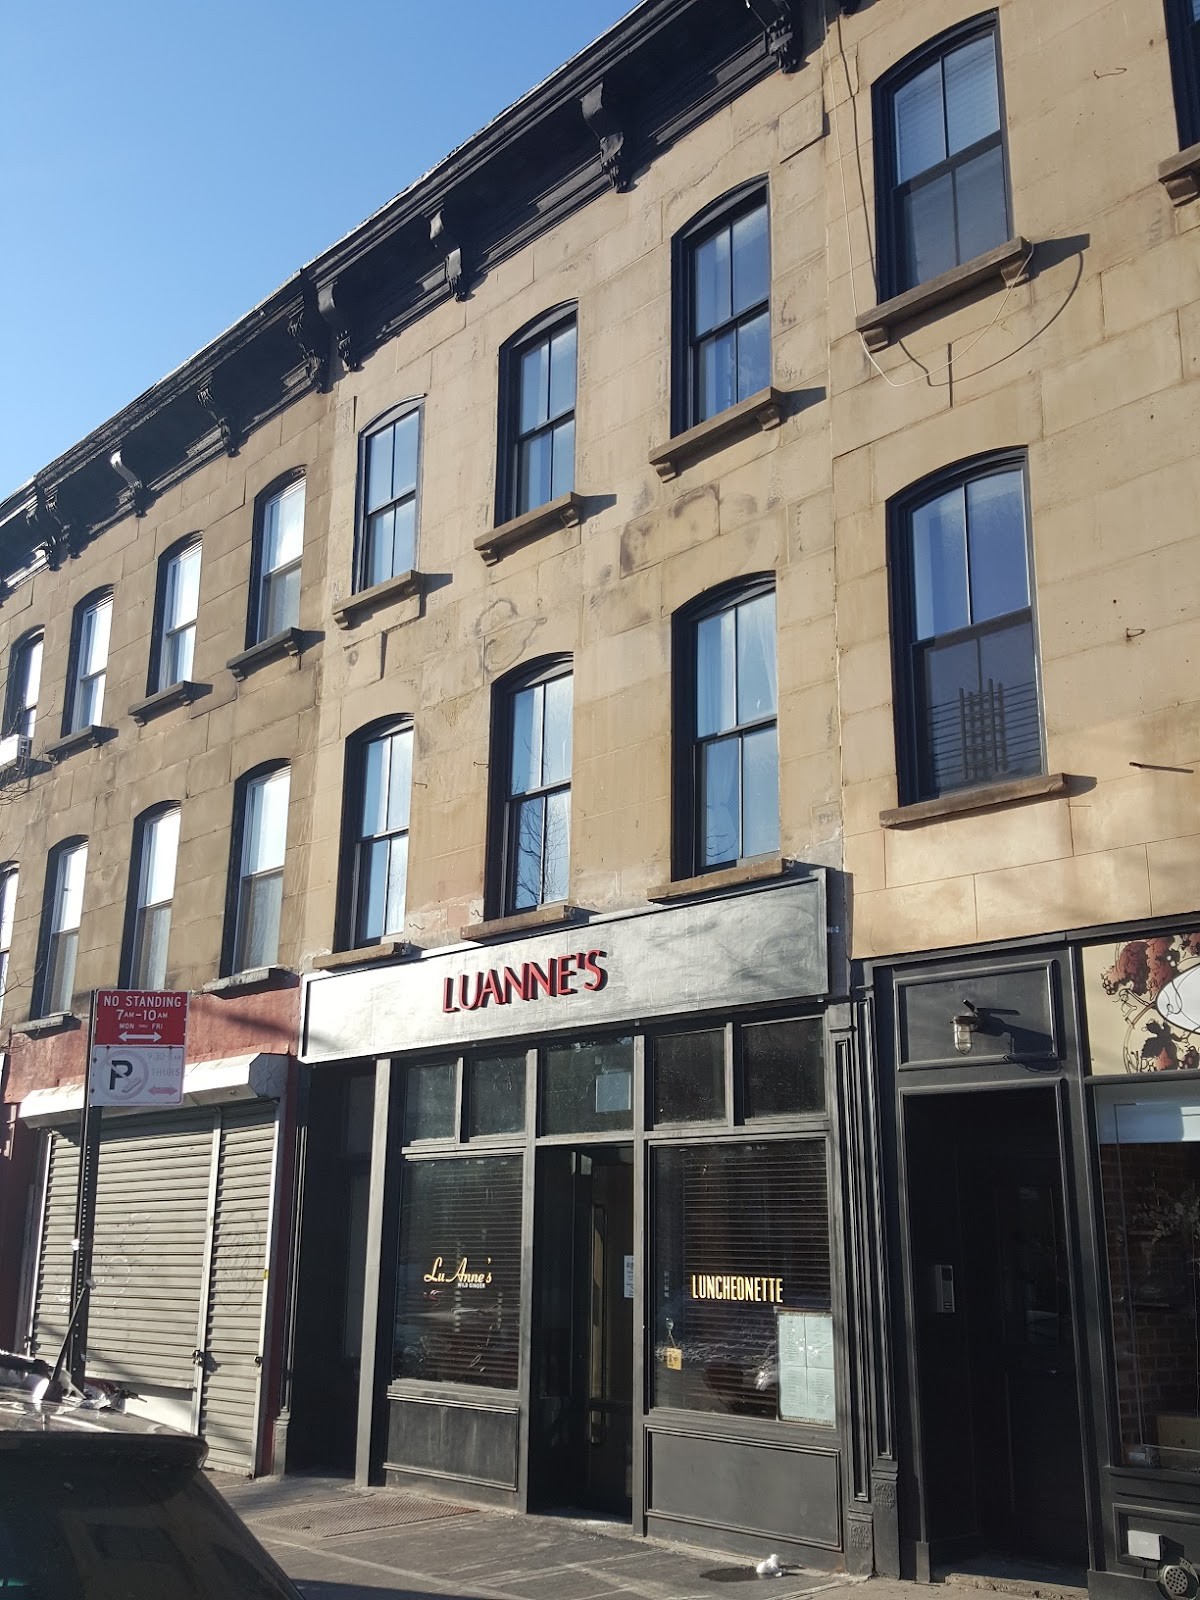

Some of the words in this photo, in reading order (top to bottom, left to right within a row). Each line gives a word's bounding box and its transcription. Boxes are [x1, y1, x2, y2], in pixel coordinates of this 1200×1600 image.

[443, 950, 608, 1013] LUANNE'S
[103, 995, 120, 1006] NO
[125, 995, 182, 1008] STANDING
[119, 1022, 135, 1030] MON
[151, 1022, 163, 1030] FRI
[692, 1274, 784, 1303] LUNCHEONETTE
